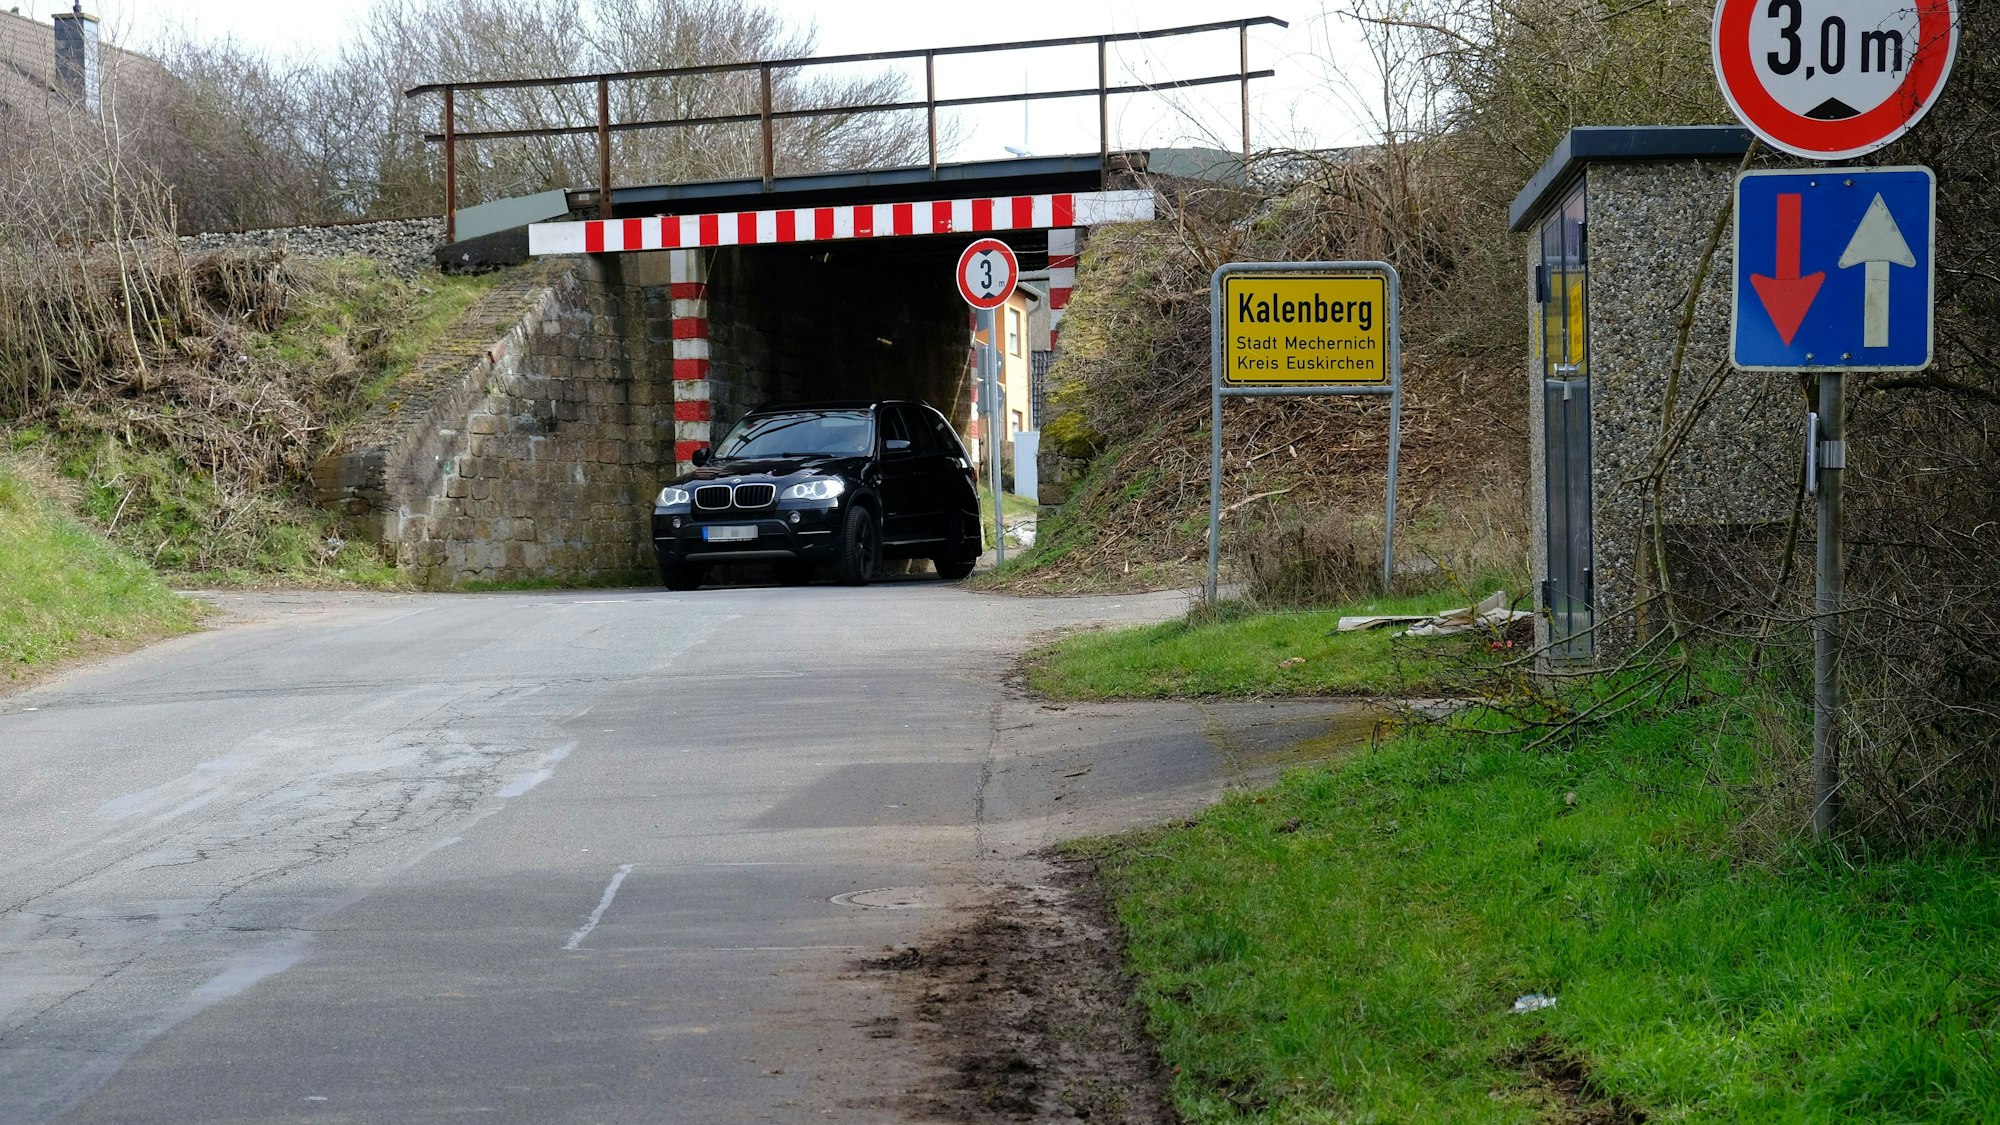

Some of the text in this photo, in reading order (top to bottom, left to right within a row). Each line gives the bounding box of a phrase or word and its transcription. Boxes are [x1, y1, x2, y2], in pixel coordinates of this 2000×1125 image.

[1766, 0, 1903, 81] 3,0 m
[980, 259, 993, 290] 3
[1239, 292, 1373, 332] Kalenberg
[1236, 336, 1376, 350] Stadt Mechernich
[1237, 356, 1375, 370] Kreis Euskirchen
